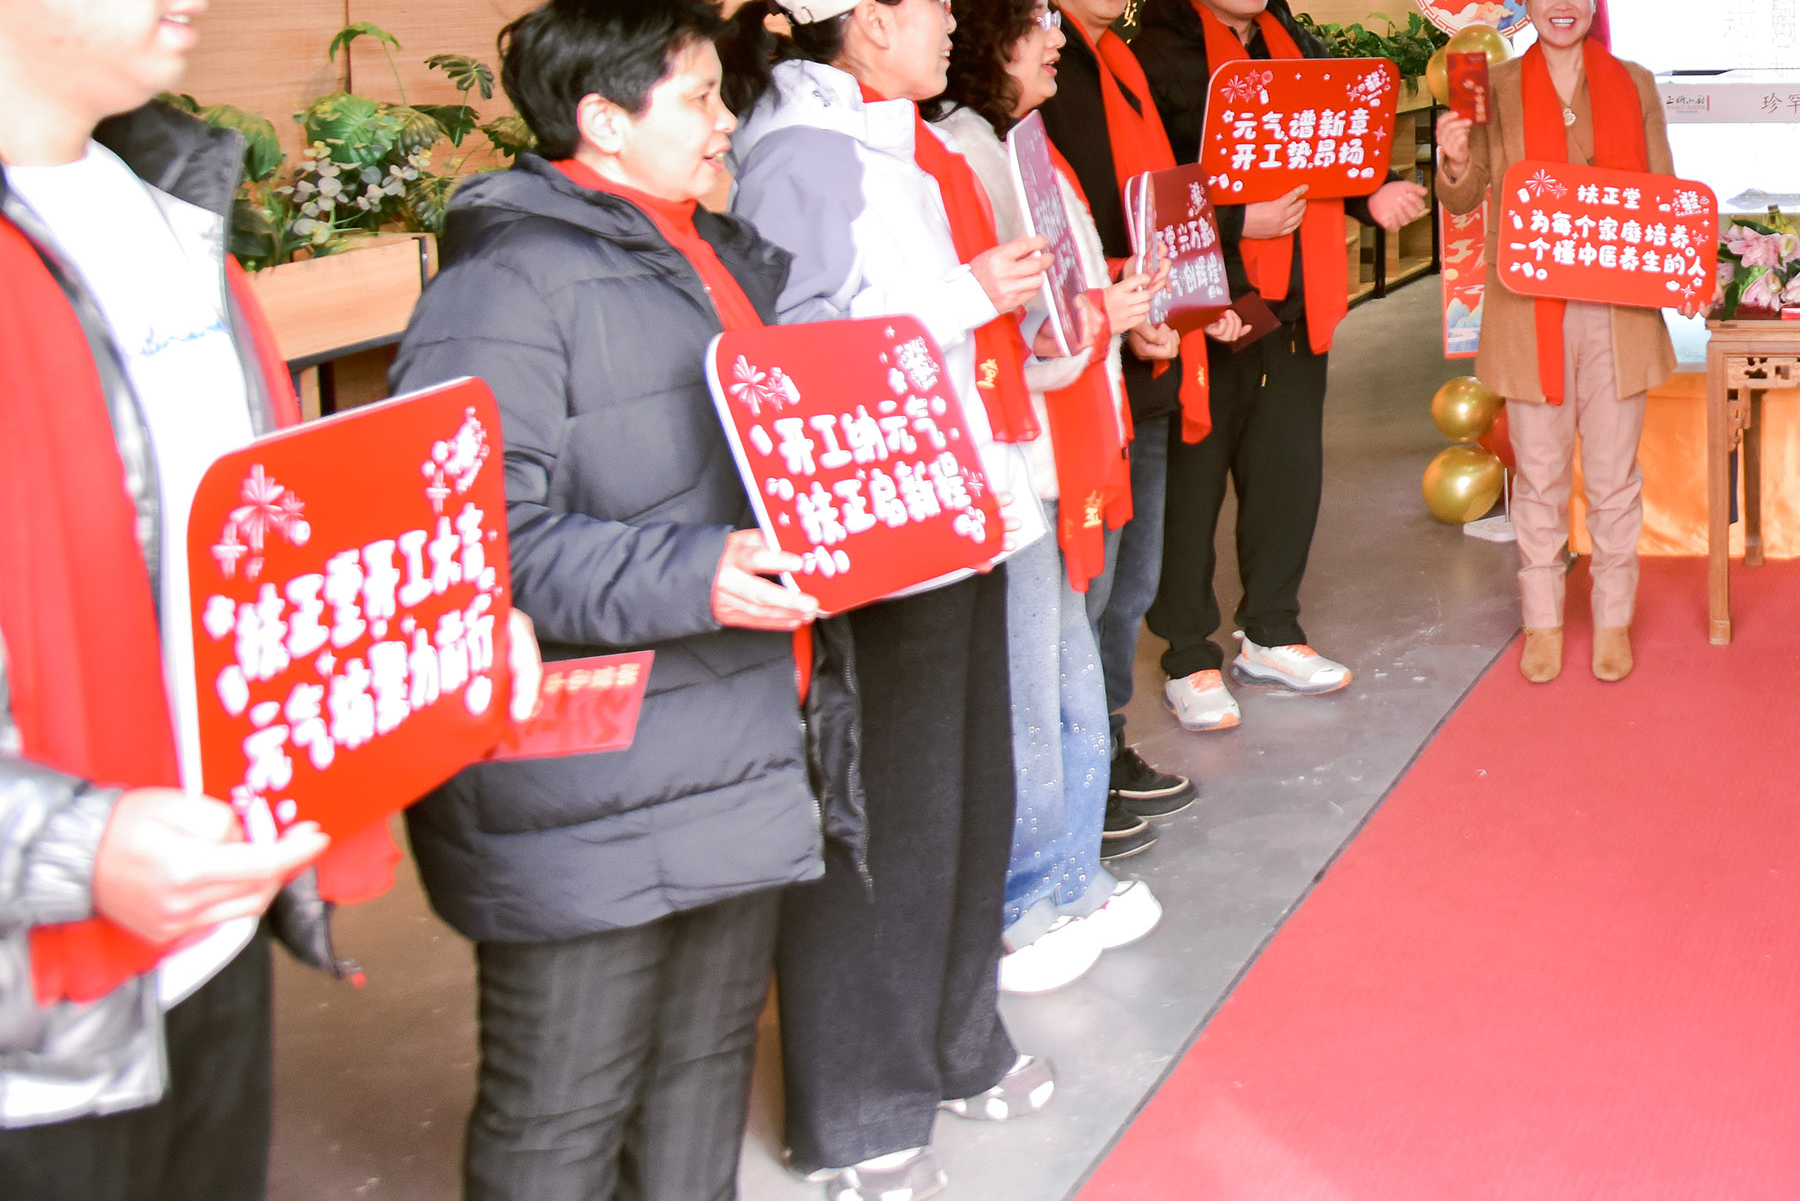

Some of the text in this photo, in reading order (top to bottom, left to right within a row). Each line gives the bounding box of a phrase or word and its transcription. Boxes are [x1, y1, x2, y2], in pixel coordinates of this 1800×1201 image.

[1232, 107, 1371, 140] 元气谱新章
[1231, 138, 1366, 171] 开工势昂扬
[1577, 183, 1641, 210] 扶正堂
[1530, 209, 1691, 250] 为每个家庭培养
[1510, 237, 1707, 277] 一个懂中医养生的人
[234, 501, 486, 682] 扶正堂开工大吉
